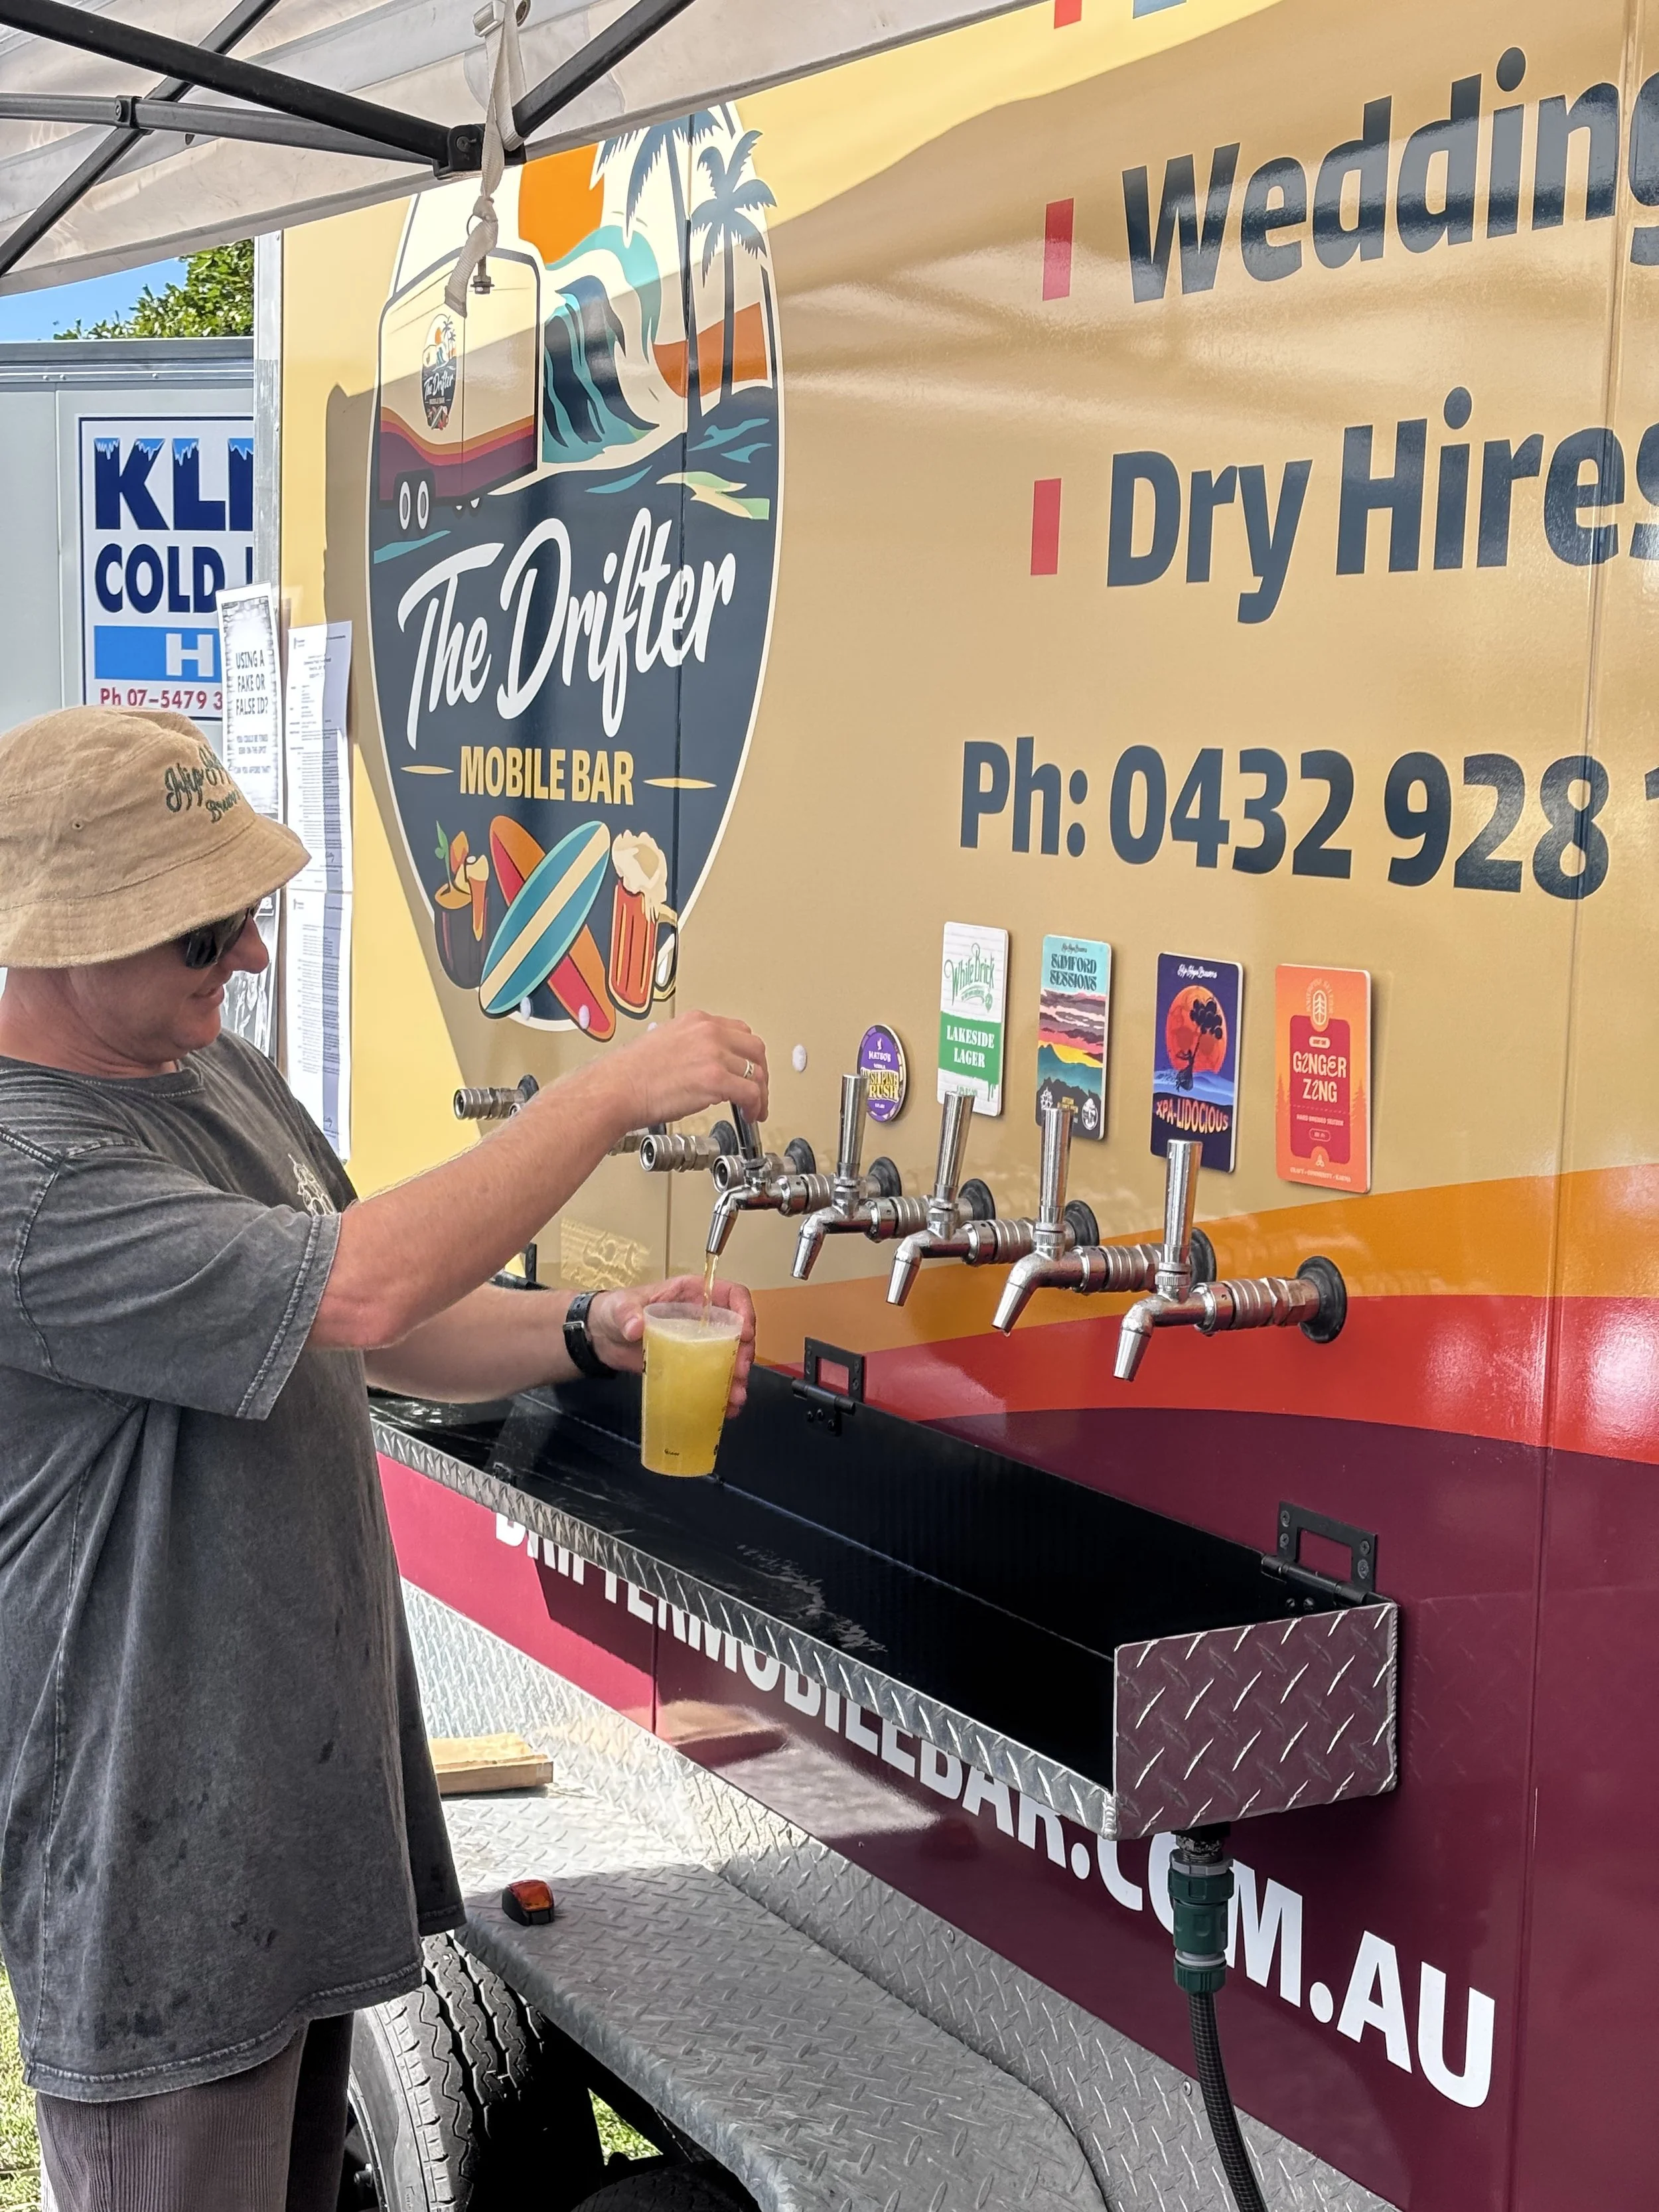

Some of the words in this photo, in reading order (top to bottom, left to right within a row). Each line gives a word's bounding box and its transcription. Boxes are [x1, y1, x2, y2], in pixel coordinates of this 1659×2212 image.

[1107, 451, 1313, 625] Dry
[95, 543, 225, 614] COLD
[398, 542, 504, 750] The
[496, 508, 737, 737] Drifter
[235, 651, 257, 670] USING
[257, 650, 265, 668] A
[100, 688, 121, 706] Ph
[238, 675, 254, 694] FAKE
[255, 674, 265, 692] OR
[236, 698, 255, 716] FALSE
[257, 697, 269, 715] ID?
[459, 745, 565, 800] MOBILE
[571, 750, 636, 805] BAR
[960, 736, 1088, 857] Ph:
[1110, 744, 1355, 880] 0432
[1384, 751, 1611, 900] 928
[943, 957, 974, 1006] White
[971, 942, 995, 990] Brick
[1050, 970, 1097, 992] SESSIONS
[946, 1025, 995, 1049] LAKESIDE
[954, 1047, 985, 1068] LAGER
[1155, 1098, 1229, 1134] XPA-LIDOCIOUS
